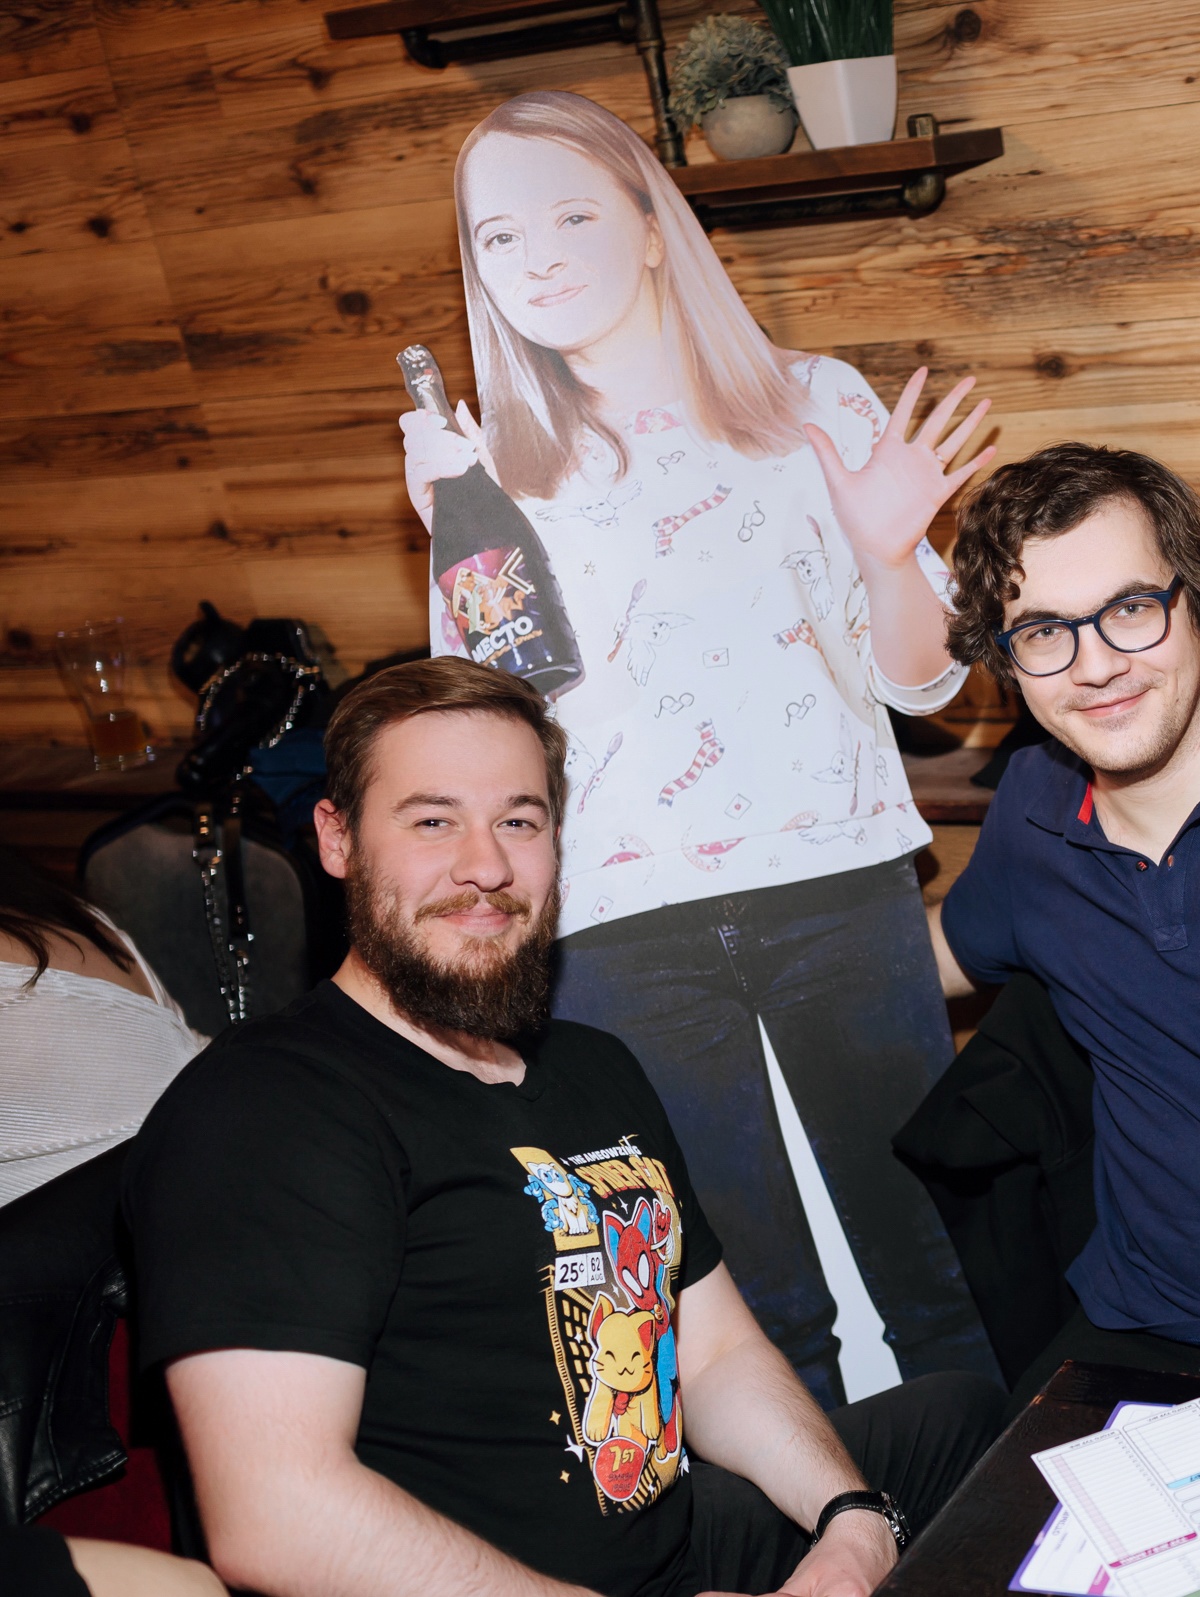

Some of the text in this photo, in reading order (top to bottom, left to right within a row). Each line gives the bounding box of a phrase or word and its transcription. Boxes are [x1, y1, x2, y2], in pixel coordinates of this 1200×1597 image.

[568, 1154, 584, 1166] THE
[590, 1256, 600, 1272] 62
[591, 1272, 604, 1282] AUG
